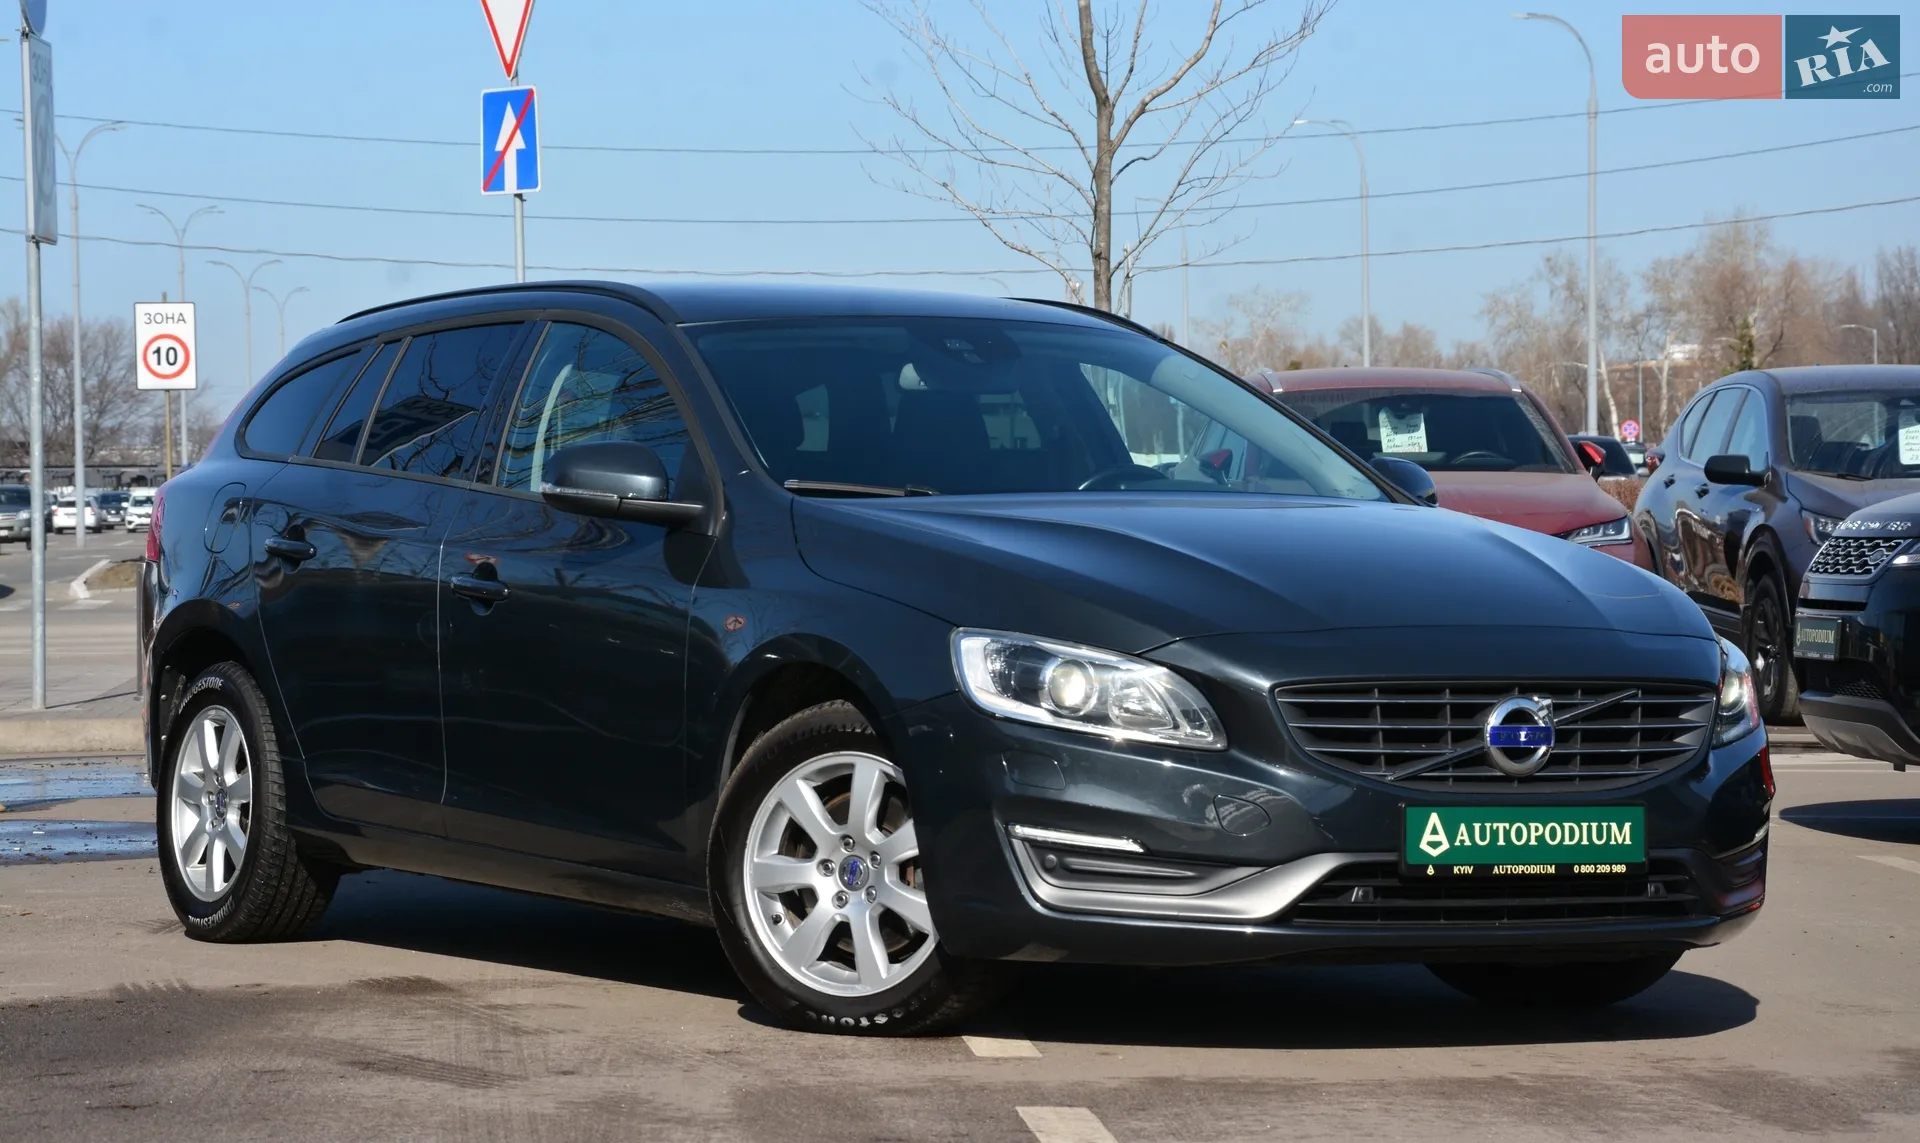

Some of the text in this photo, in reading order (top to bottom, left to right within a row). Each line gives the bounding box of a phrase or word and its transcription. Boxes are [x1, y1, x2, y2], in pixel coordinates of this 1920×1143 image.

[143, 312, 187, 325] ЗОНА
[152, 346, 178, 367] 10
[1800, 628, 1835, 644] AUTOPODIUM
[1454, 821, 1632, 846] AUTOPODIUM
[1453, 864, 1626, 875] KYIV AUTOPODIUM 0 800 209 989
